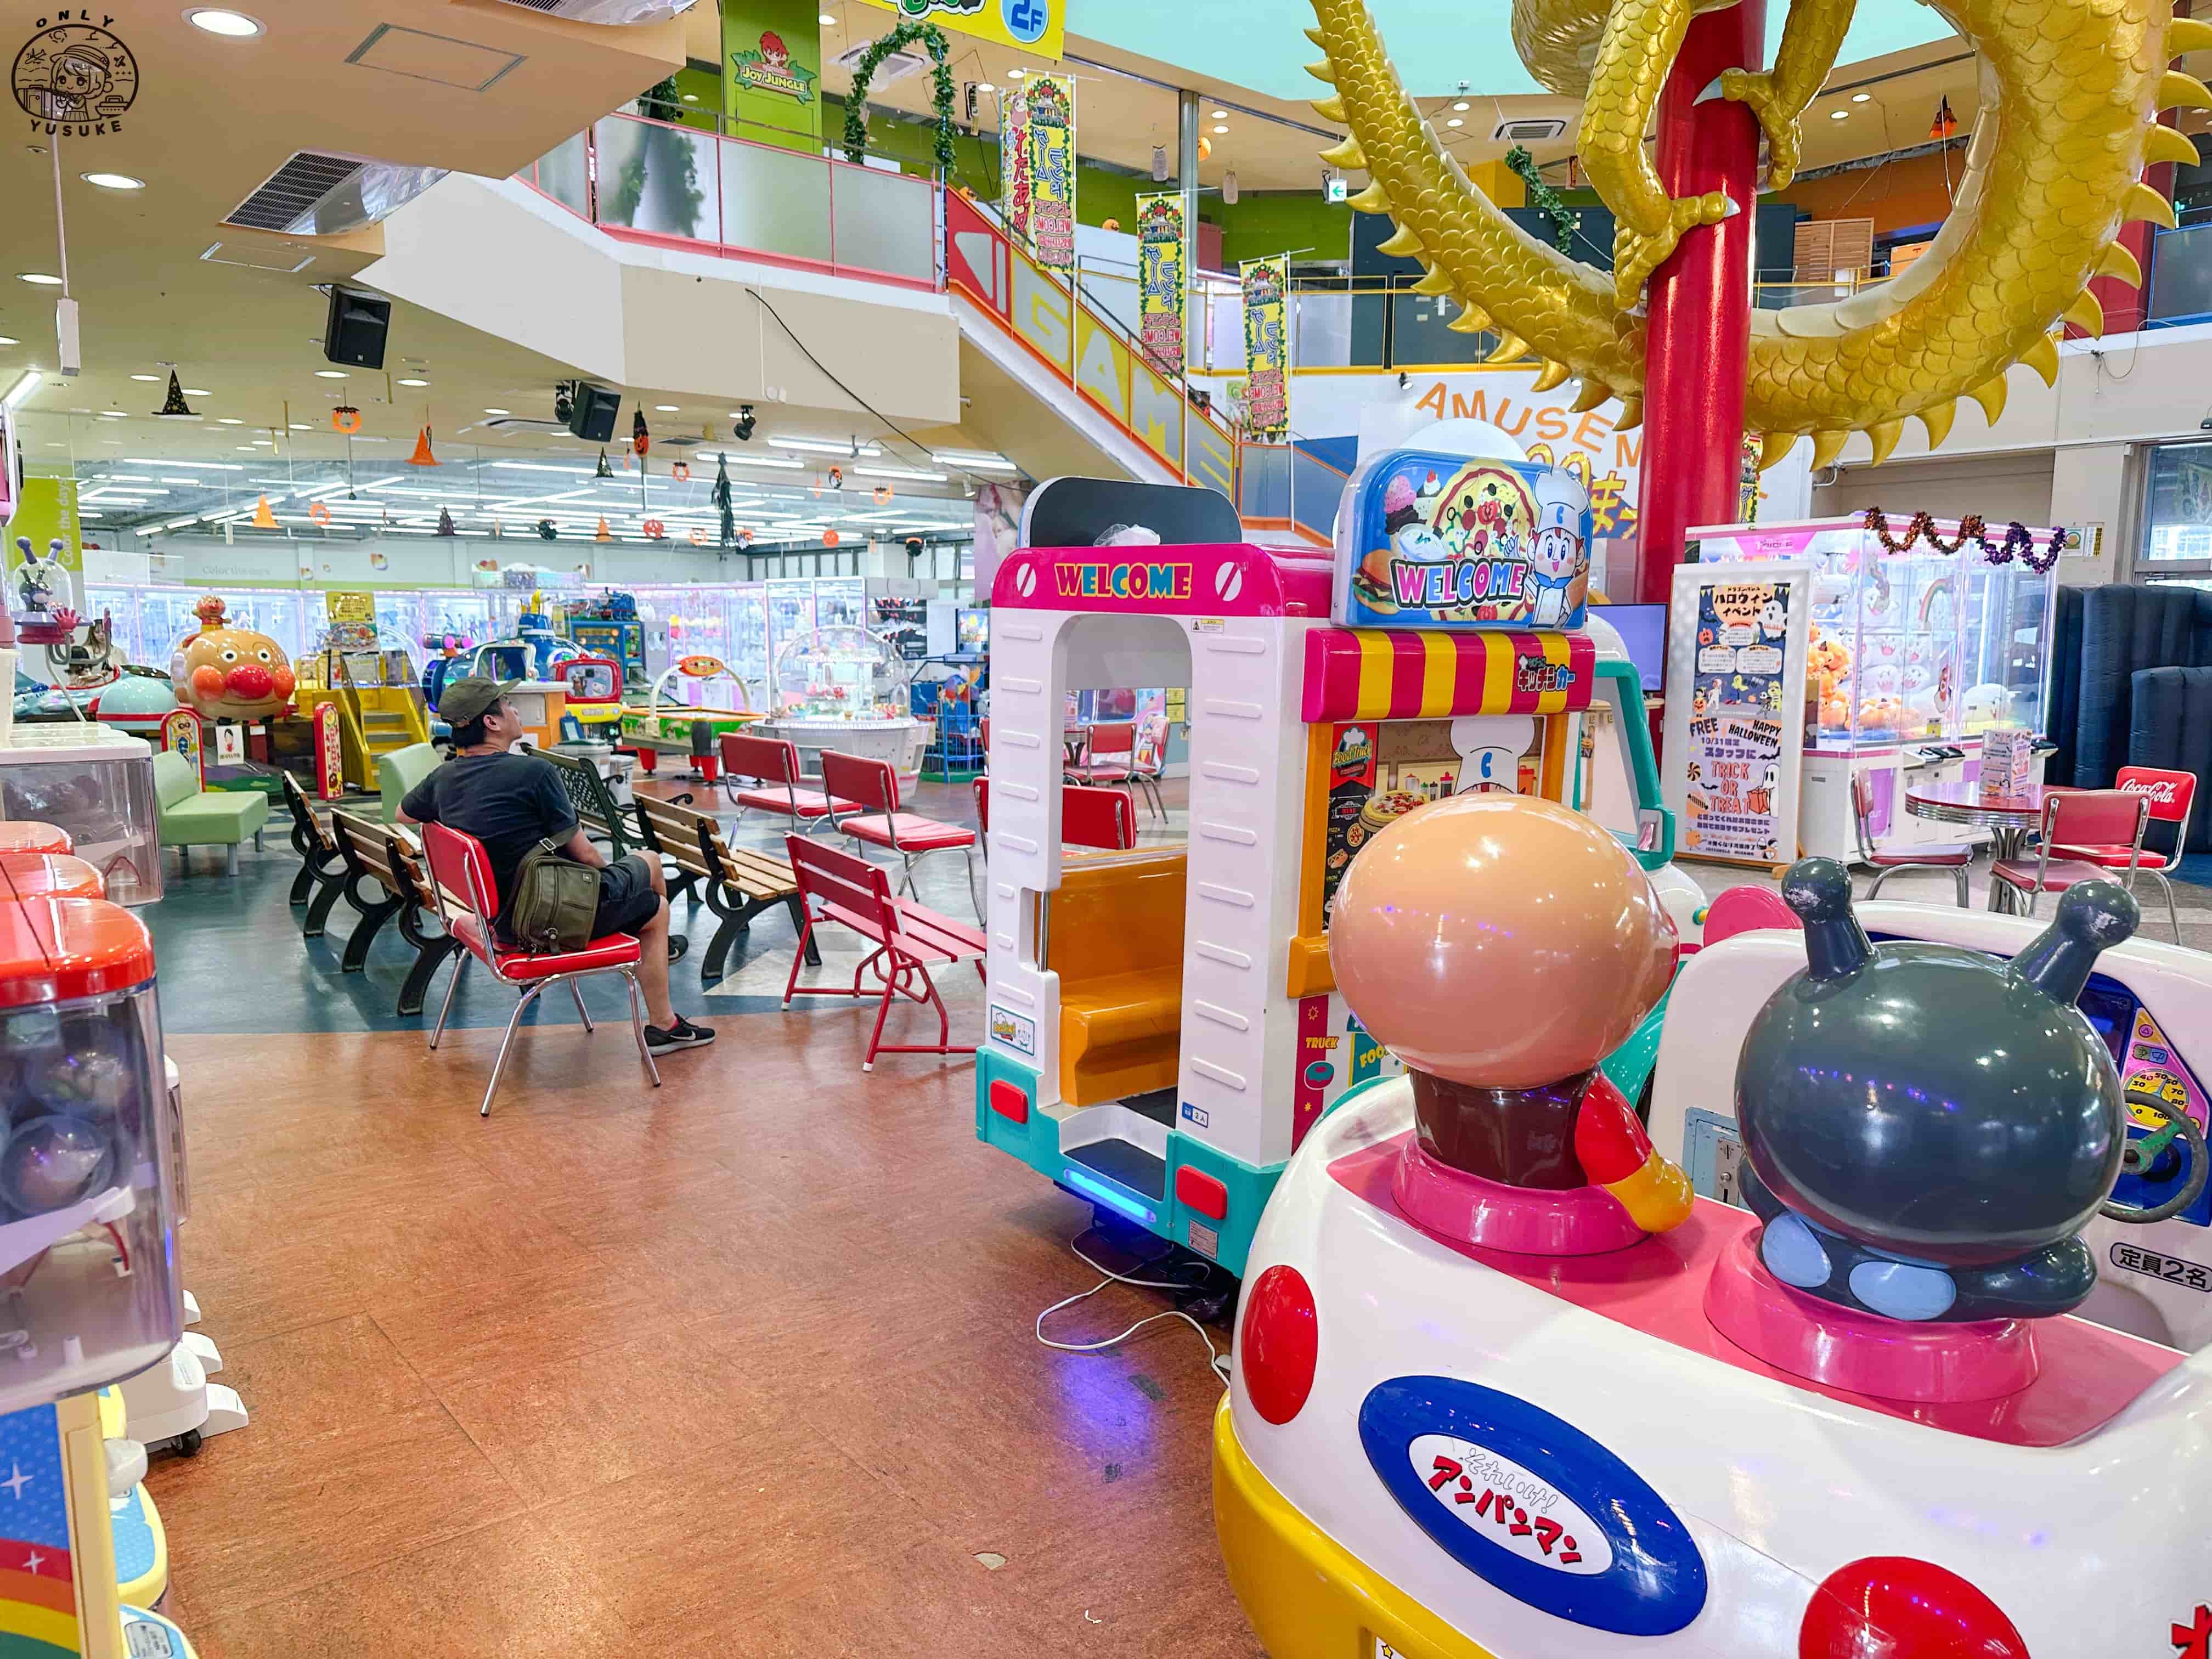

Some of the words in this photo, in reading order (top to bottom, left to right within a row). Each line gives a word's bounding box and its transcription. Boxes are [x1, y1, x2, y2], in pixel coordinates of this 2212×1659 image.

[741, 66, 763, 83] JOY
[764, 72, 807, 93] JUNGLE
[1054, 562, 1193, 600] WELCOME
[1391, 559, 1529, 609] WELCOME
[1714, 592, 1774, 605] ハロウィン
[1722, 607, 1762, 617] イベント
[1517, 666, 1576, 692] キッチンカー
[1689, 718, 1719, 738] FREE
[1729, 724, 1778, 749] HALLOWEEN
[1752, 719, 1782, 737] HAPPY
[1705, 747, 1757, 760] スタッフに
[1711, 760, 1751, 781] TRICK
[1720, 779, 1739, 797] OR
[1710, 795, 1750, 815] TREAT
[1305, 1036, 1339, 1049] TRUCK
[1359, 1046, 1388, 1068] FOO
[2119, 1249, 2209, 1290] 定員2名
[1427, 1454, 1583, 1565] アンパンマン
